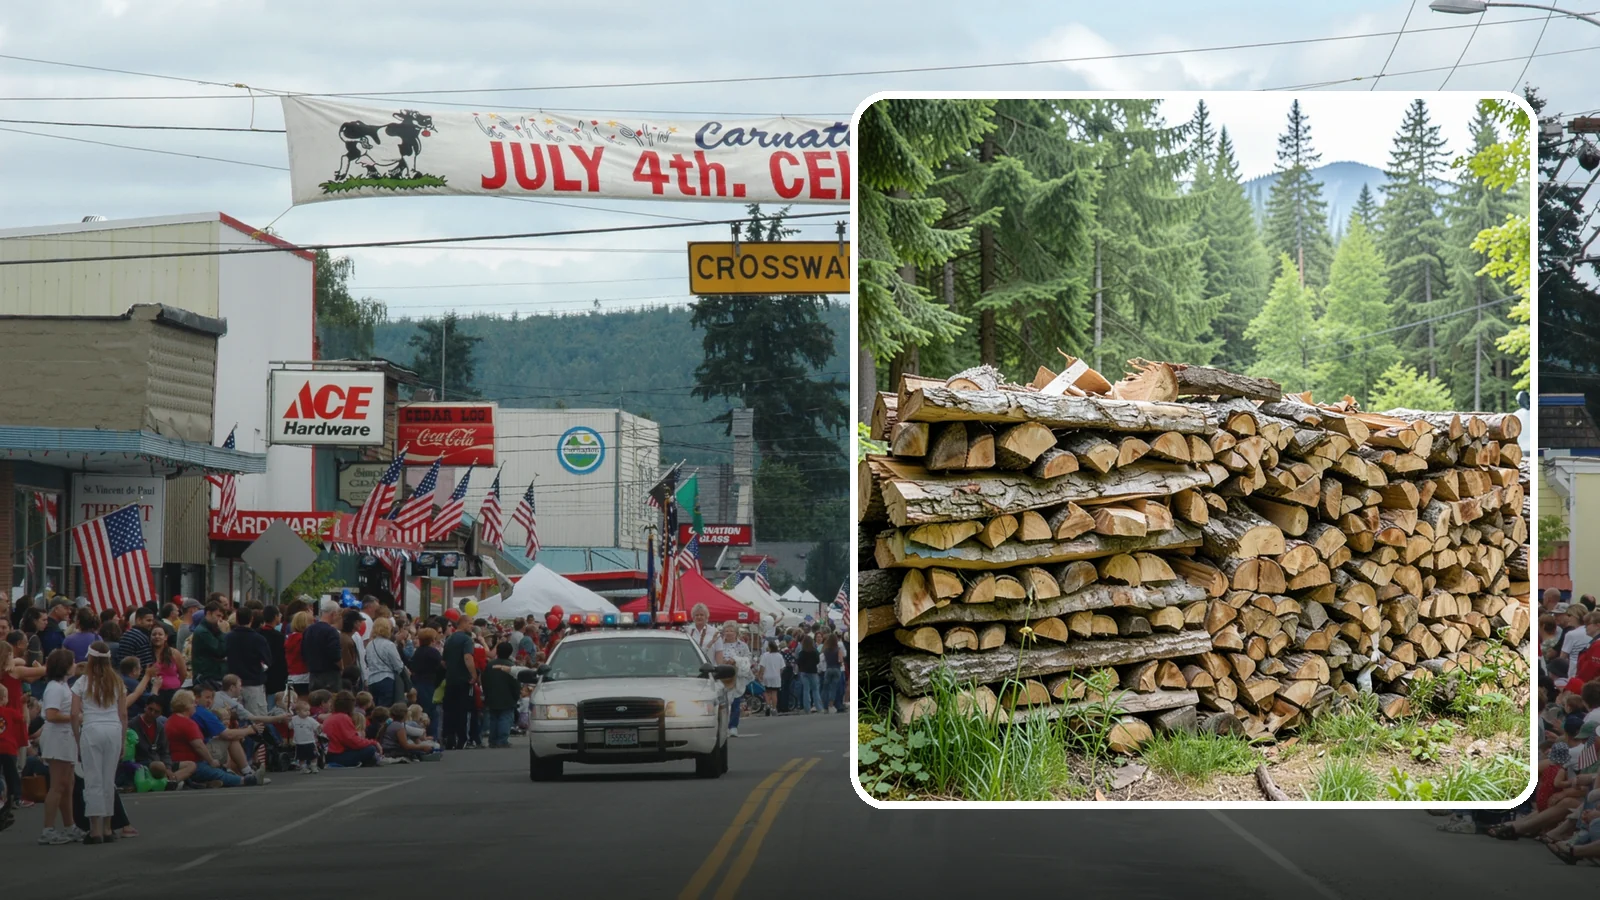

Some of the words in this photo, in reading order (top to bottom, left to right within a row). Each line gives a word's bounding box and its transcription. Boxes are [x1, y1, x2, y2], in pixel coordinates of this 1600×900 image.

[481, 141, 605, 193] JULY
[632, 150, 747, 198] 4th.
[697, 254, 850, 280] CROSSWA
[282, 380, 374, 420] ACE
[405, 409, 453, 422] CEDAR
[283, 421, 371, 436] Hardware
[416, 427, 477, 447] Coca-Cola
[353, 467, 386, 480] Simpl
[95, 485, 124, 495] Vincent
[126, 486, 136, 495] de
[137, 486, 155, 495] Paul
[212, 516, 331, 535] HARDARE
[688, 526, 741, 535] CRNATION
[699, 535, 730, 543] GLASS
